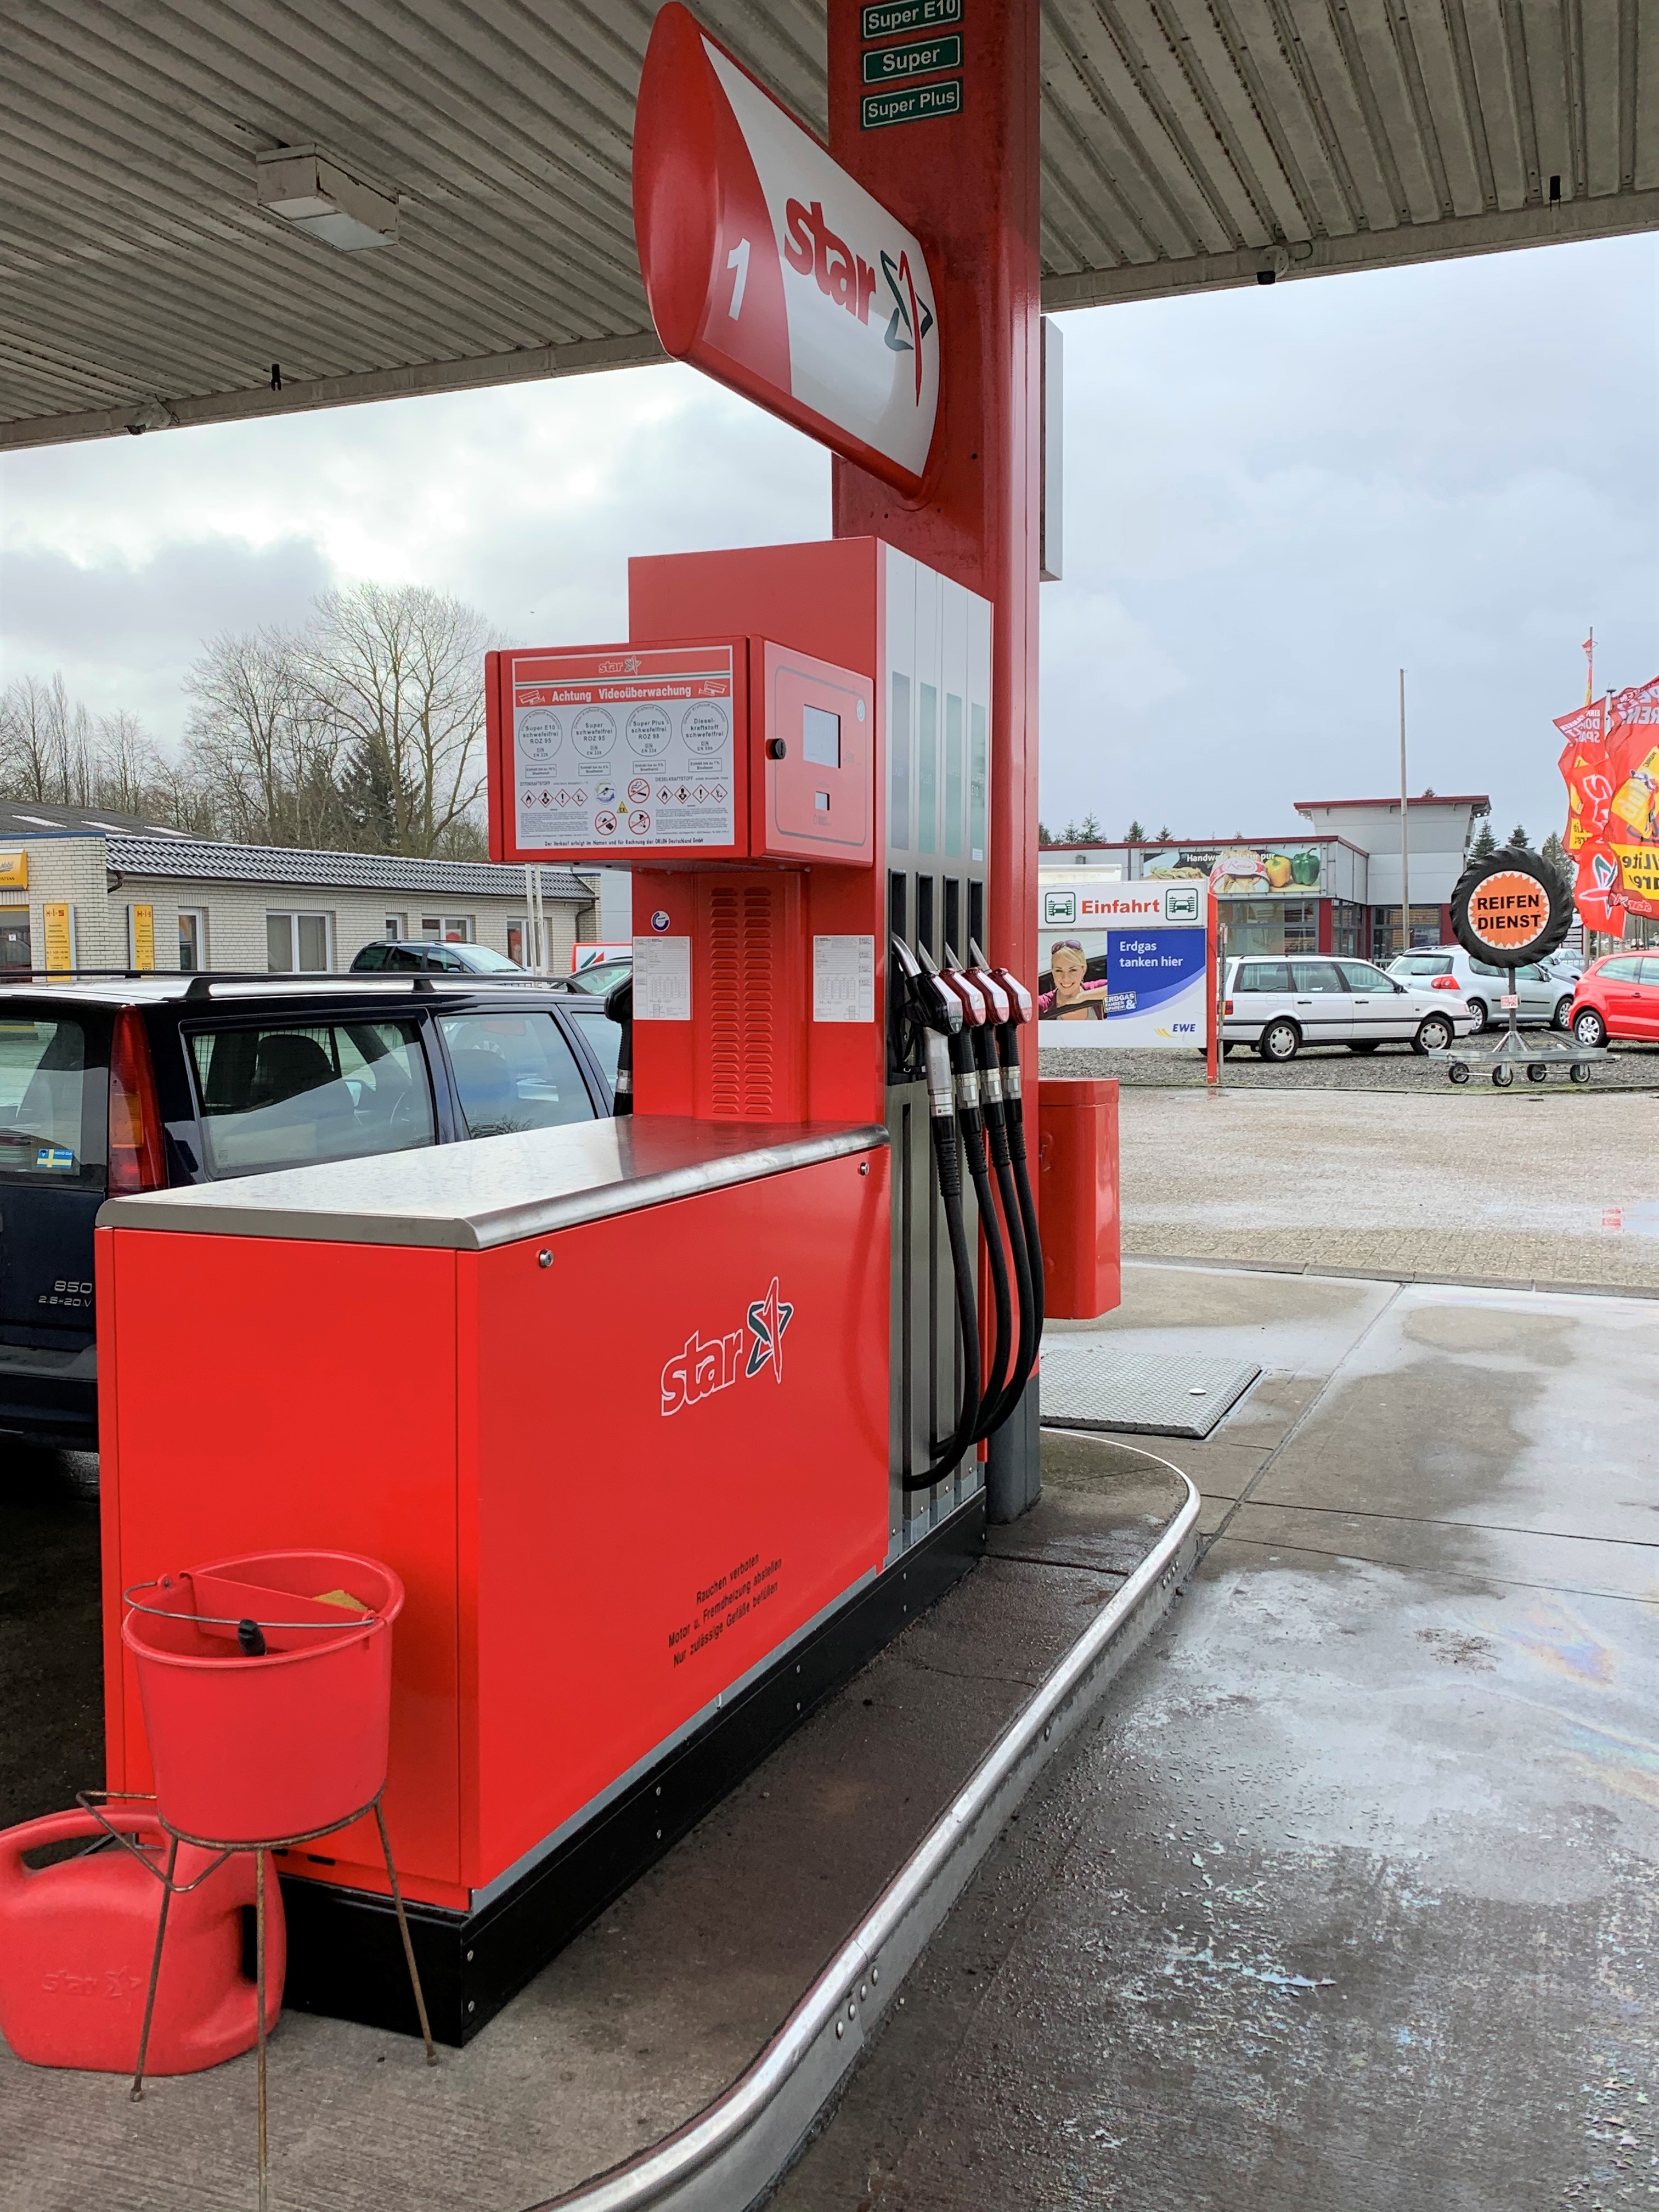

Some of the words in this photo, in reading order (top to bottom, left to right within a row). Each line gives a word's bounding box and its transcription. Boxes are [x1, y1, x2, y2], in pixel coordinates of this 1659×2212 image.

[868, 8, 919, 29] Super
[924, 0, 956, 18] E10
[883, 48, 940, 72] Super
[868, 99, 916, 118] Super
[919, 92, 955, 108] Plus
[785, 198, 877, 326] star
[727, 238, 751, 321] 1
[598, 661, 623, 673] star
[552, 690, 592, 702] Achtung
[598, 685, 692, 700] Videoüberwachung
[1260, 853, 1276, 862] pur
[1082, 899, 1160, 914] Einfahrt
[1477, 894, 1539, 910] REIFEN
[1477, 915, 1542, 930] DIENST
[1119, 940, 1157, 954] Erdgas
[1119, 956, 1158, 968] tanken
[1161, 956, 1183, 967] hier
[1104, 993, 1135, 1003] ERDGAS
[1126, 1000, 1136, 1009] &
[1172, 1024, 1196, 1032] EWE
[54, 1280, 93, 1294] 850
[661, 1329, 743, 1417] star
[696, 1576, 727, 1606] Rauchen
[730, 1553, 759, 1581] verboten
[668, 1623, 690, 1649] Motor
[693, 1619, 701, 1630] u.
[703, 1581, 751, 1624] Fremdheizung
[753, 1558, 782, 1587] abstellen
[673, 1649, 687, 1668] Nur
[690, 1622, 724, 1656] zulässige
[726, 1601, 750, 1627] Gefäße
